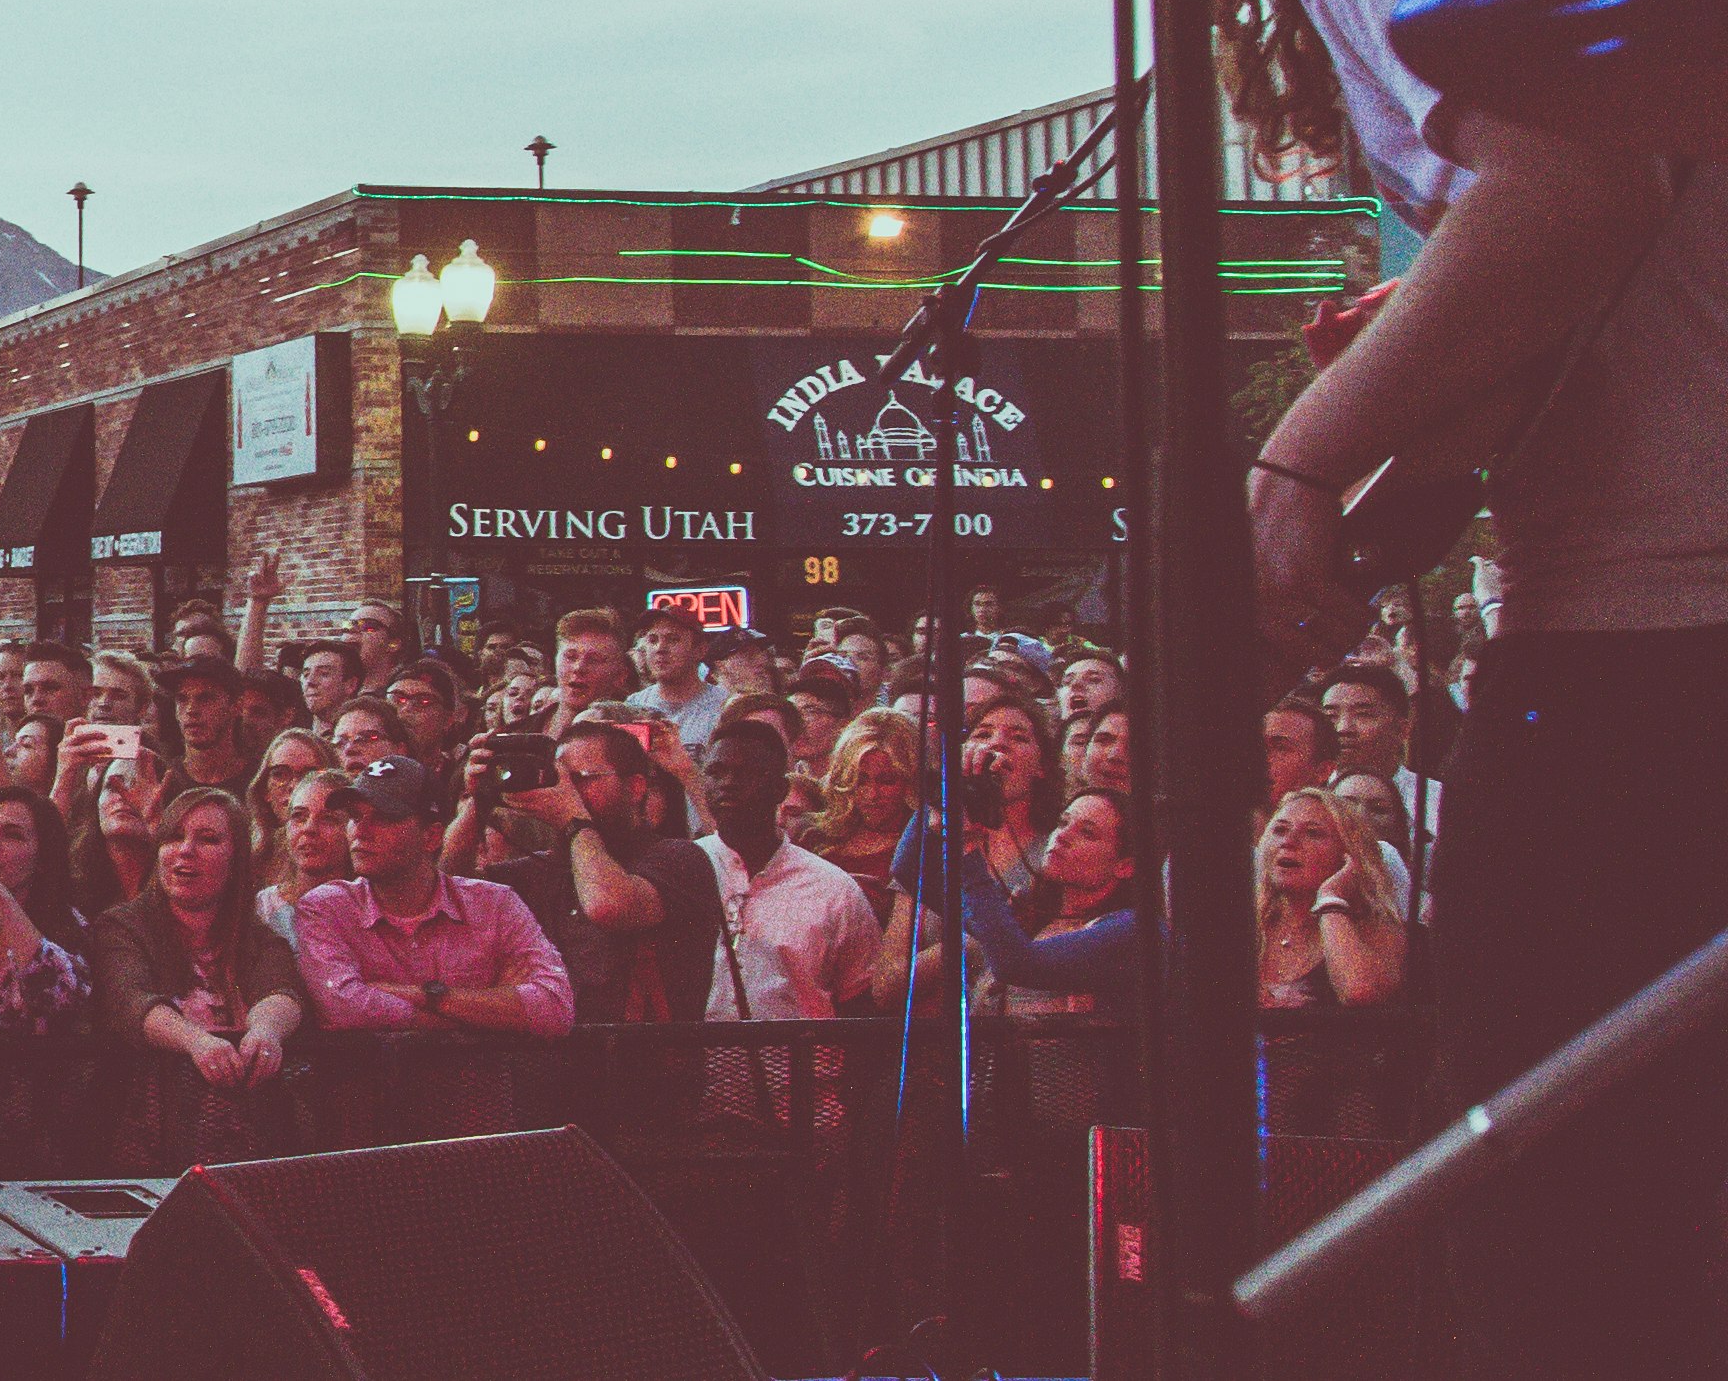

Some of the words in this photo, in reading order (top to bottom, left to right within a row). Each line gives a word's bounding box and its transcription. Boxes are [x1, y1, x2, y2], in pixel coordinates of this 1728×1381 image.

[767, 359, 866, 432] INDIA
[794, 463, 896, 487] CUISINE
[904, 467, 937, 487] OF
[953, 464, 1028, 487] INDIA
[449, 502, 627, 540] SERVING
[641, 505, 756, 541] UTAH
[842, 513, 993, 536] 373-700
[804, 556, 840, 585] 98
